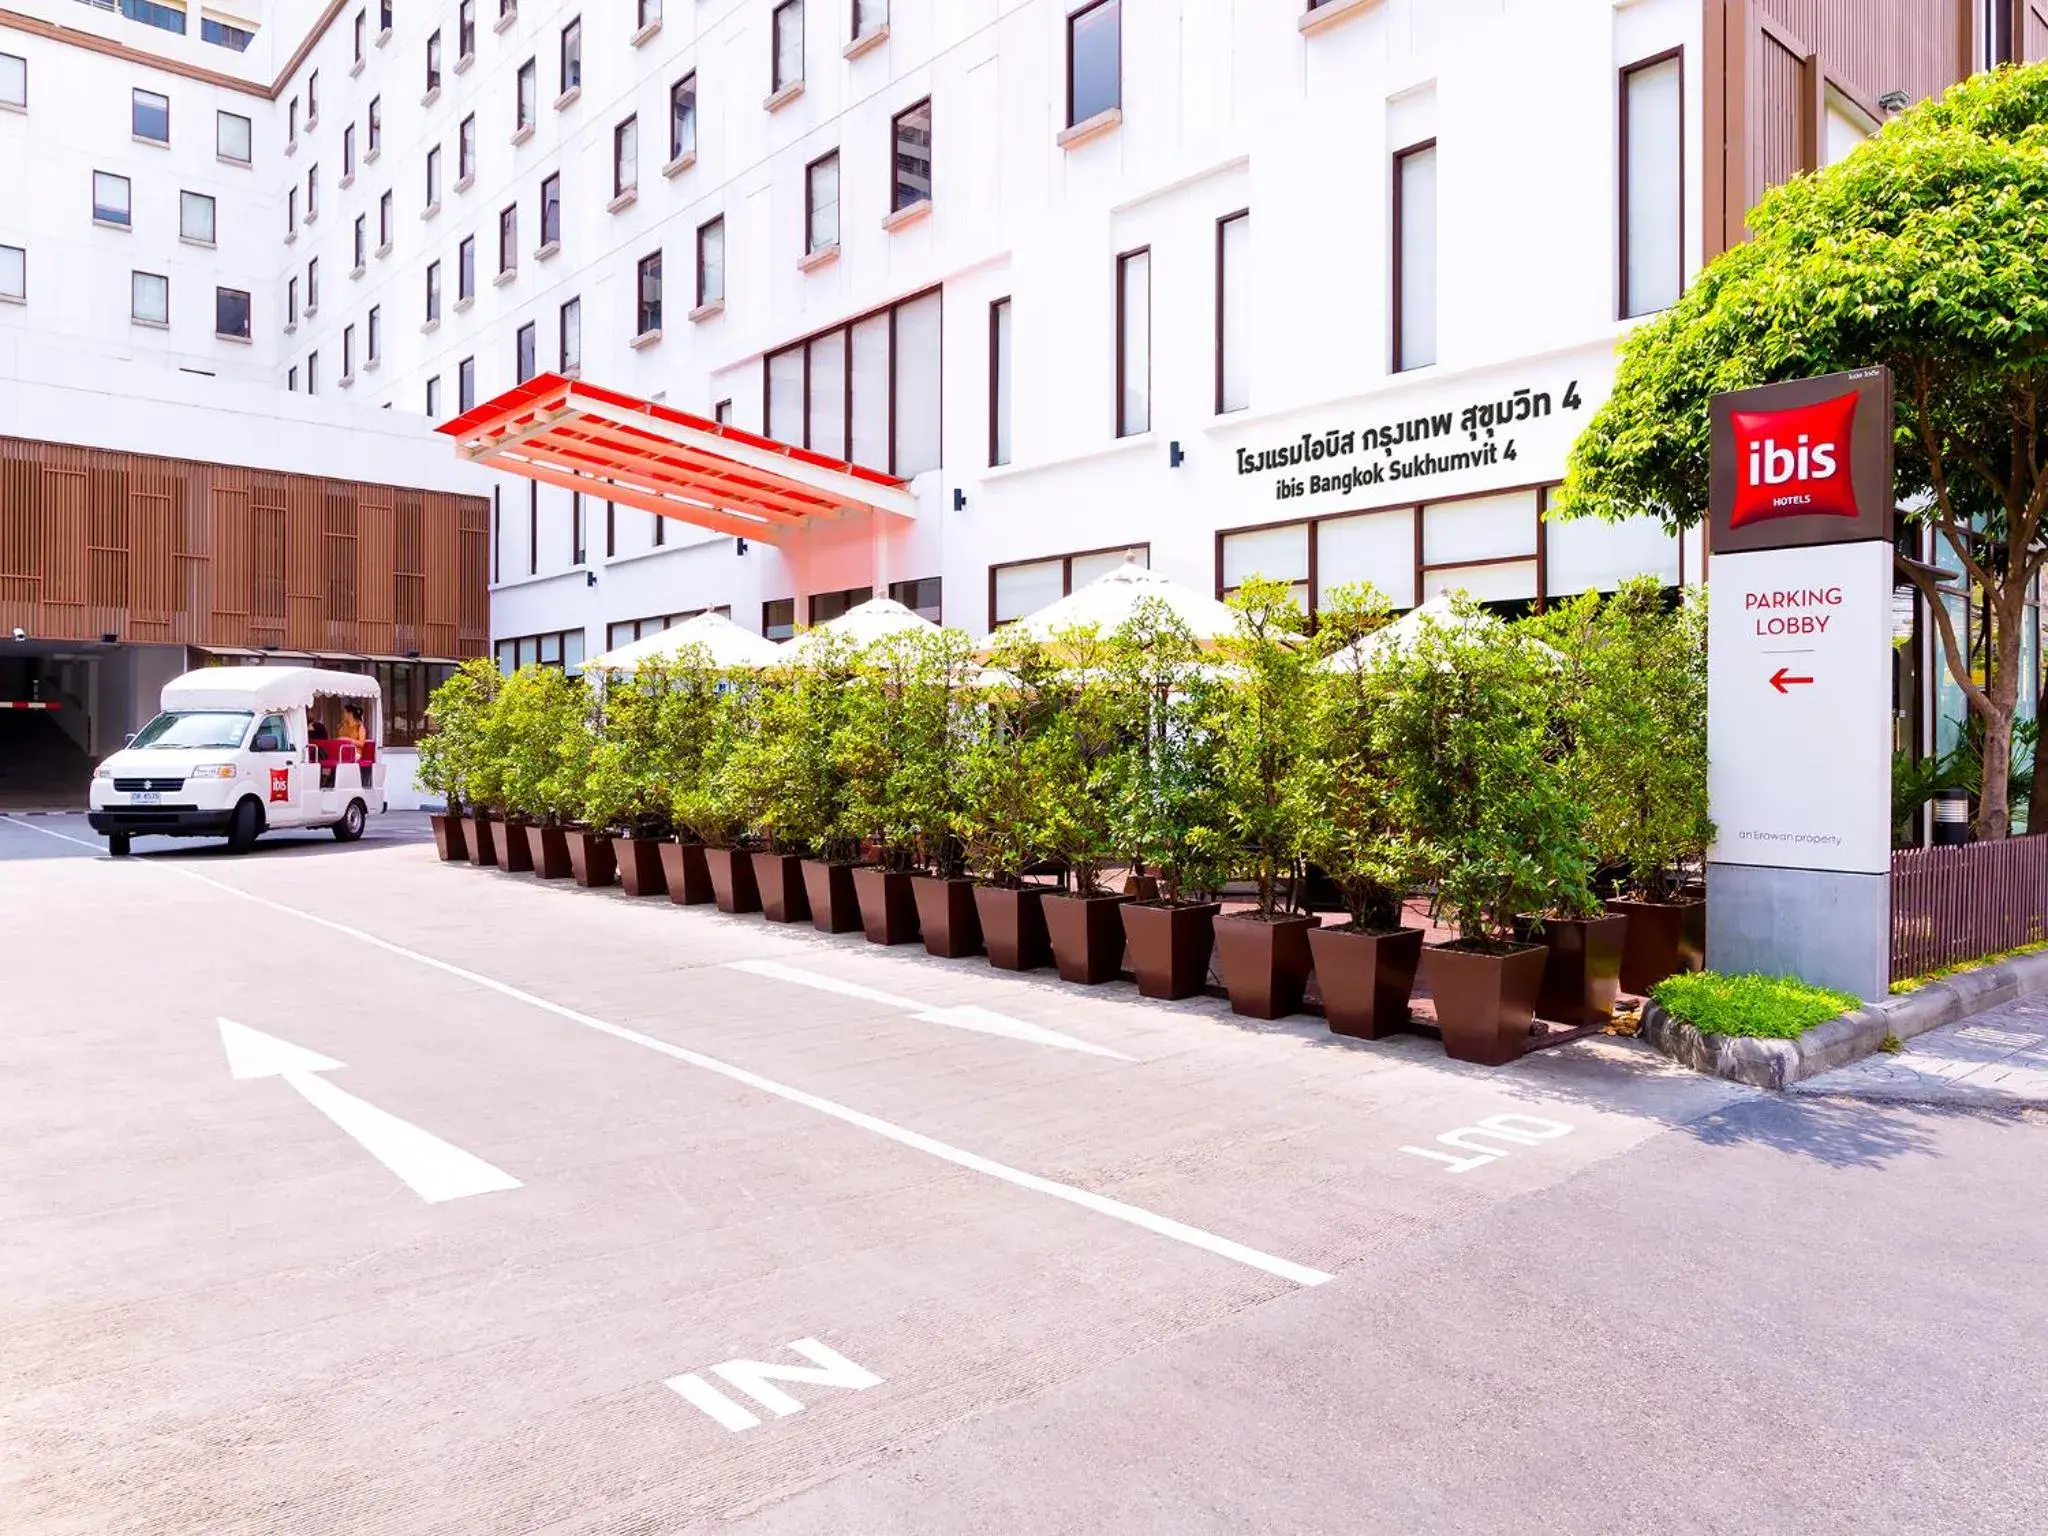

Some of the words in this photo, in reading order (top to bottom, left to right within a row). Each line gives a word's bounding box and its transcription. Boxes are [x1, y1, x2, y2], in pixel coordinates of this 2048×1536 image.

[1236, 429, 1355, 475] โรงแรมไอบิส
[1362, 412, 1453, 457] กรุงเทพ
[1461, 388, 1551, 441] สุขุมวิท
[1562, 380, 1582, 410] 4
[1276, 477, 1304, 500] ibis
[1310, 462, 1384, 495] Bangkok
[1389, 442, 1497, 481] Sukhumvit
[1503, 439, 1517, 461] 4
[1749, 433, 1837, 487] ibis
[1773, 494, 1811, 507] HOTELS
[1745, 587, 1842, 610] PARKING
[1756, 615, 1830, 636] LOBBY
[272, 776, 287, 792] ibis
[1738, 830, 1752, 840] an
[1753, 831, 1793, 841] Erawan
[1795, 834, 1842, 847] property
[1398, 1113, 1574, 1173] OUT
[663, 1337, 887, 1432] IN
